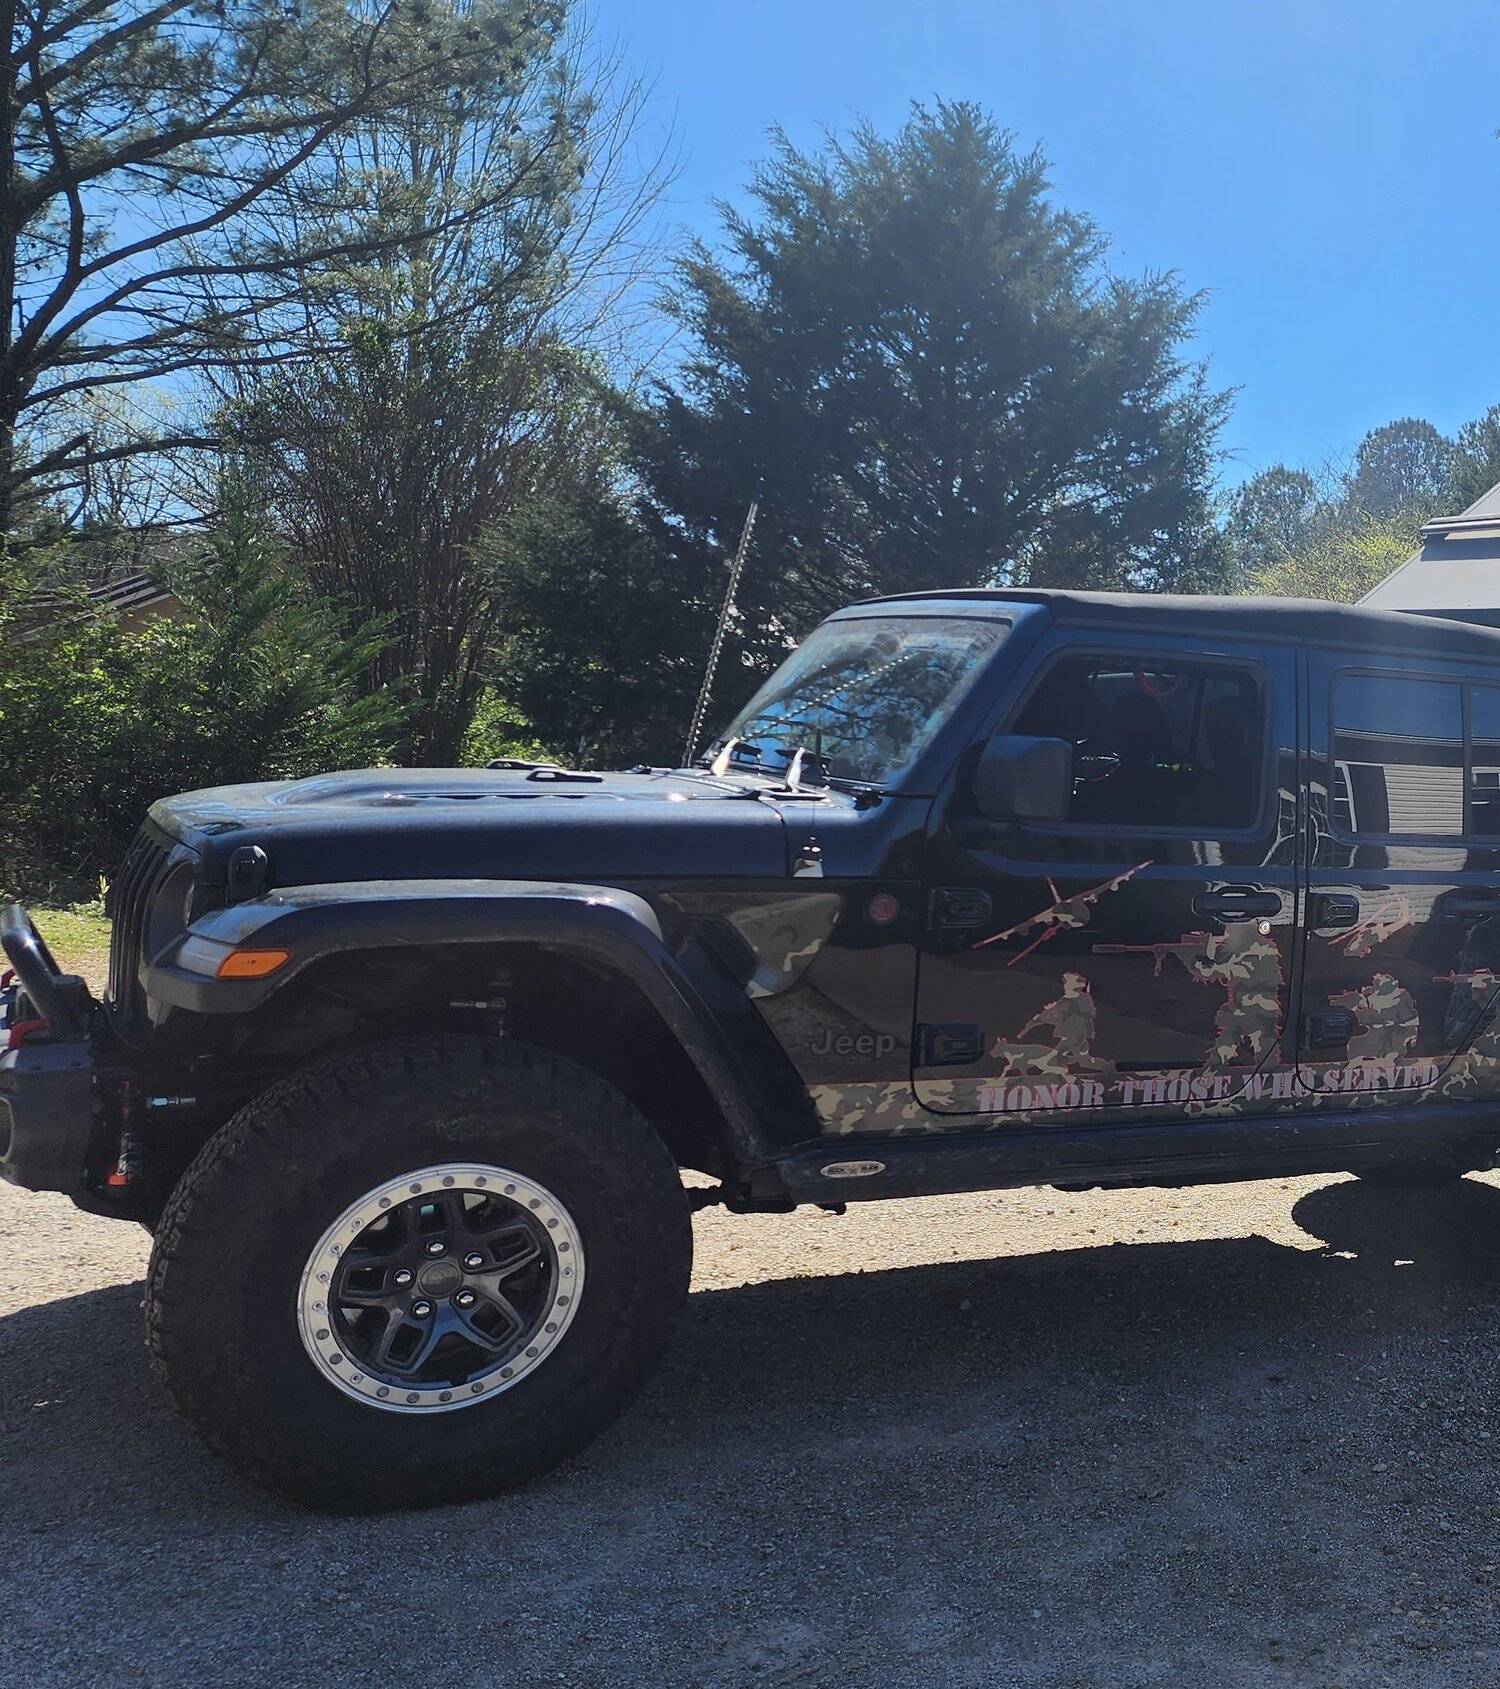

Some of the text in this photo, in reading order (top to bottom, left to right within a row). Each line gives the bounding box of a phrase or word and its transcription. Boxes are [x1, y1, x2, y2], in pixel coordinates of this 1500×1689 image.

[810, 1028, 896, 1058] Jeep
[977, 1064, 1440, 1115] HONOR THOSE WHO SERVED
